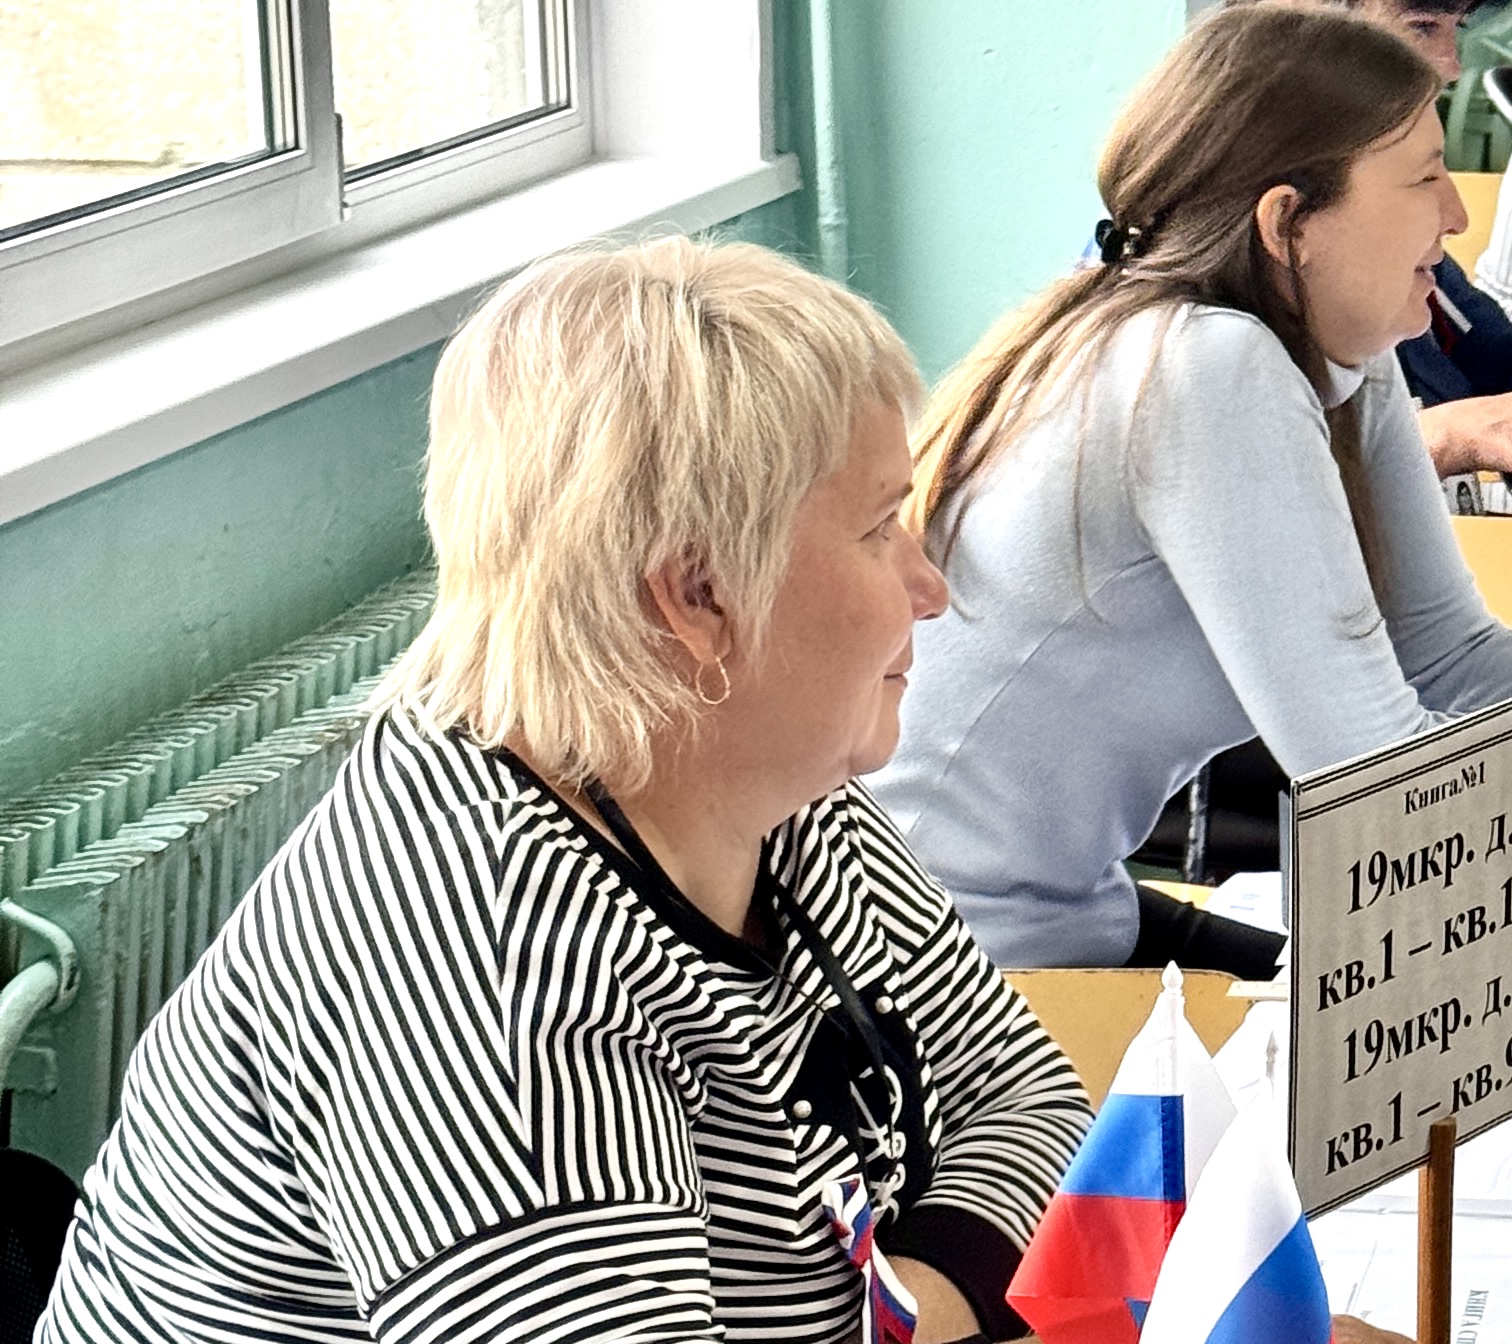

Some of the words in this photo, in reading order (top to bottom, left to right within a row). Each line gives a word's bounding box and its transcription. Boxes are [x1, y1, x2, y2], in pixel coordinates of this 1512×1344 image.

[1404, 761, 1486, 815] Книга№1
[1347, 832, 1475, 916] 19мкр.
[1317, 929, 1397, 1012] кв.1
[1343, 997, 1472, 1084] 19мкр.
[1325, 1091, 1405, 1176] кв.1
